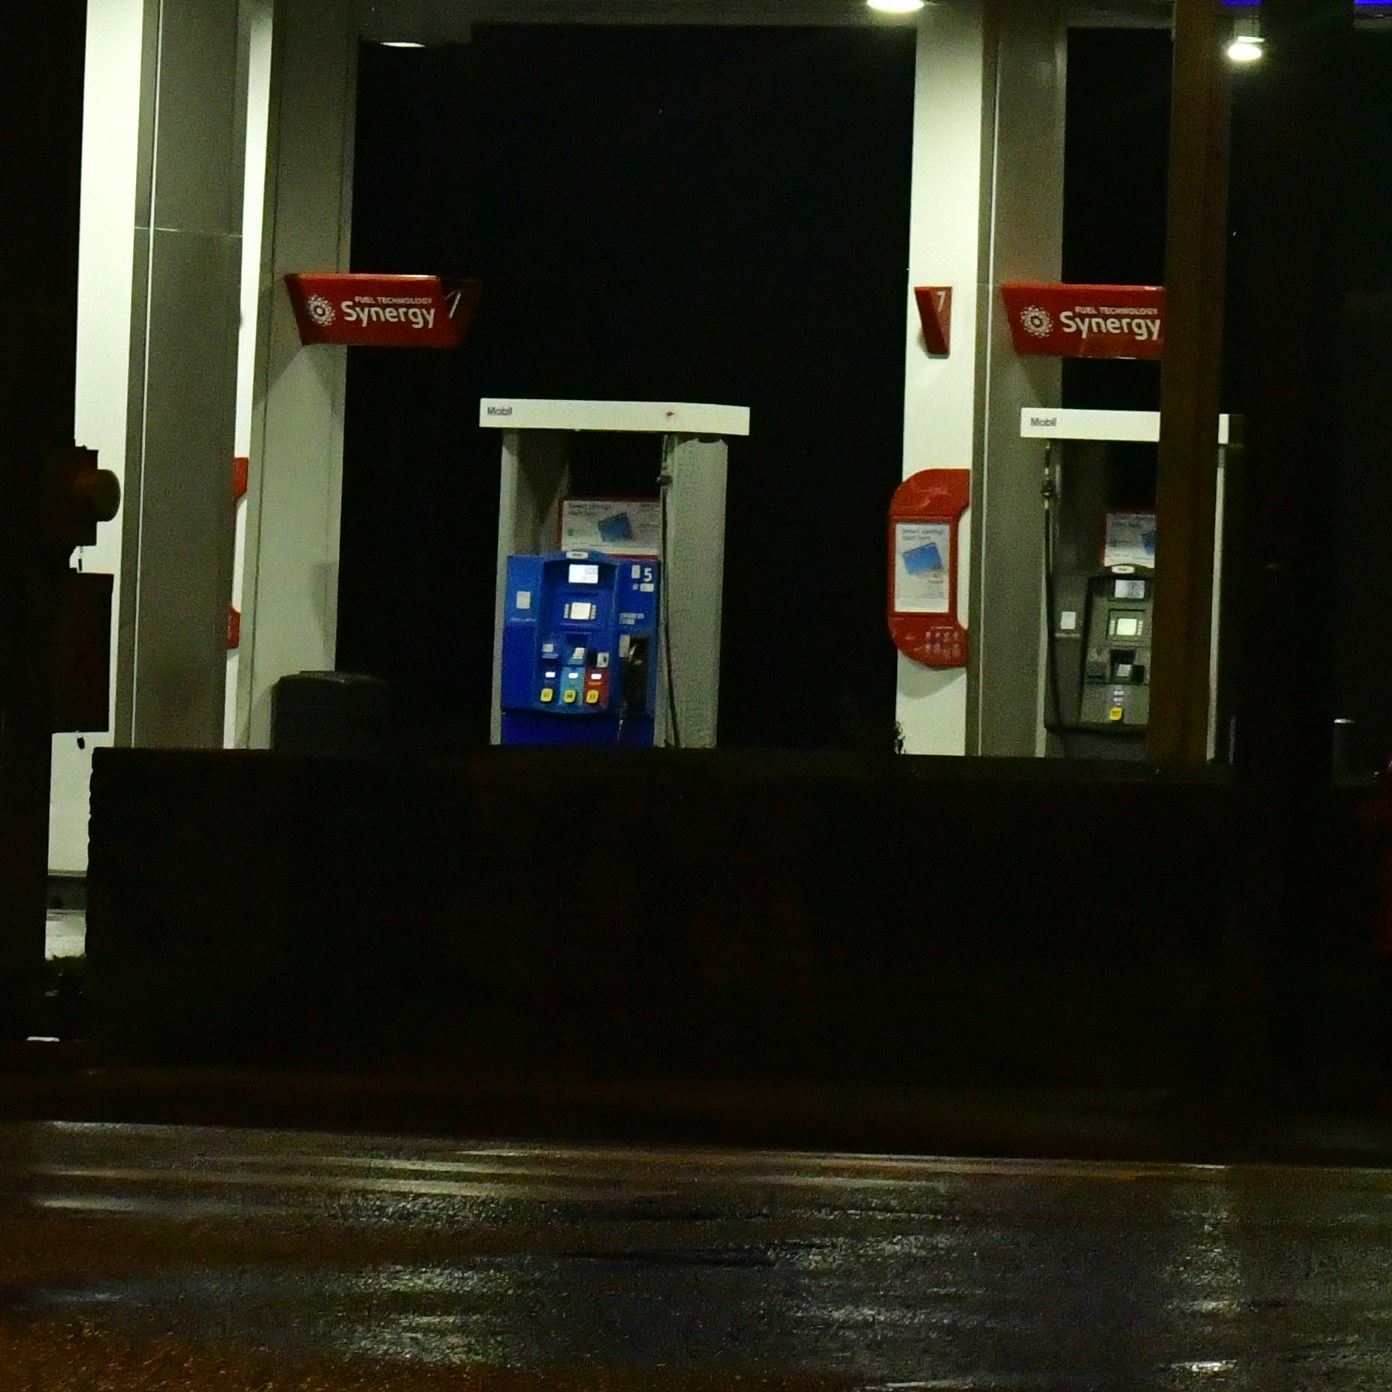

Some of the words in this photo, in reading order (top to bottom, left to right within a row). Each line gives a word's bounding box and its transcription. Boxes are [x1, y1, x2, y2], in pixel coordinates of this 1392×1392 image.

[937, 290, 947, 313] 7
[340, 300, 436, 329] Synergy
[1059, 311, 1162, 341] Synergy
[487, 406, 513, 416] Mobil
[1029, 416, 1058, 427] Mobil
[643, 567, 653, 583] 5
